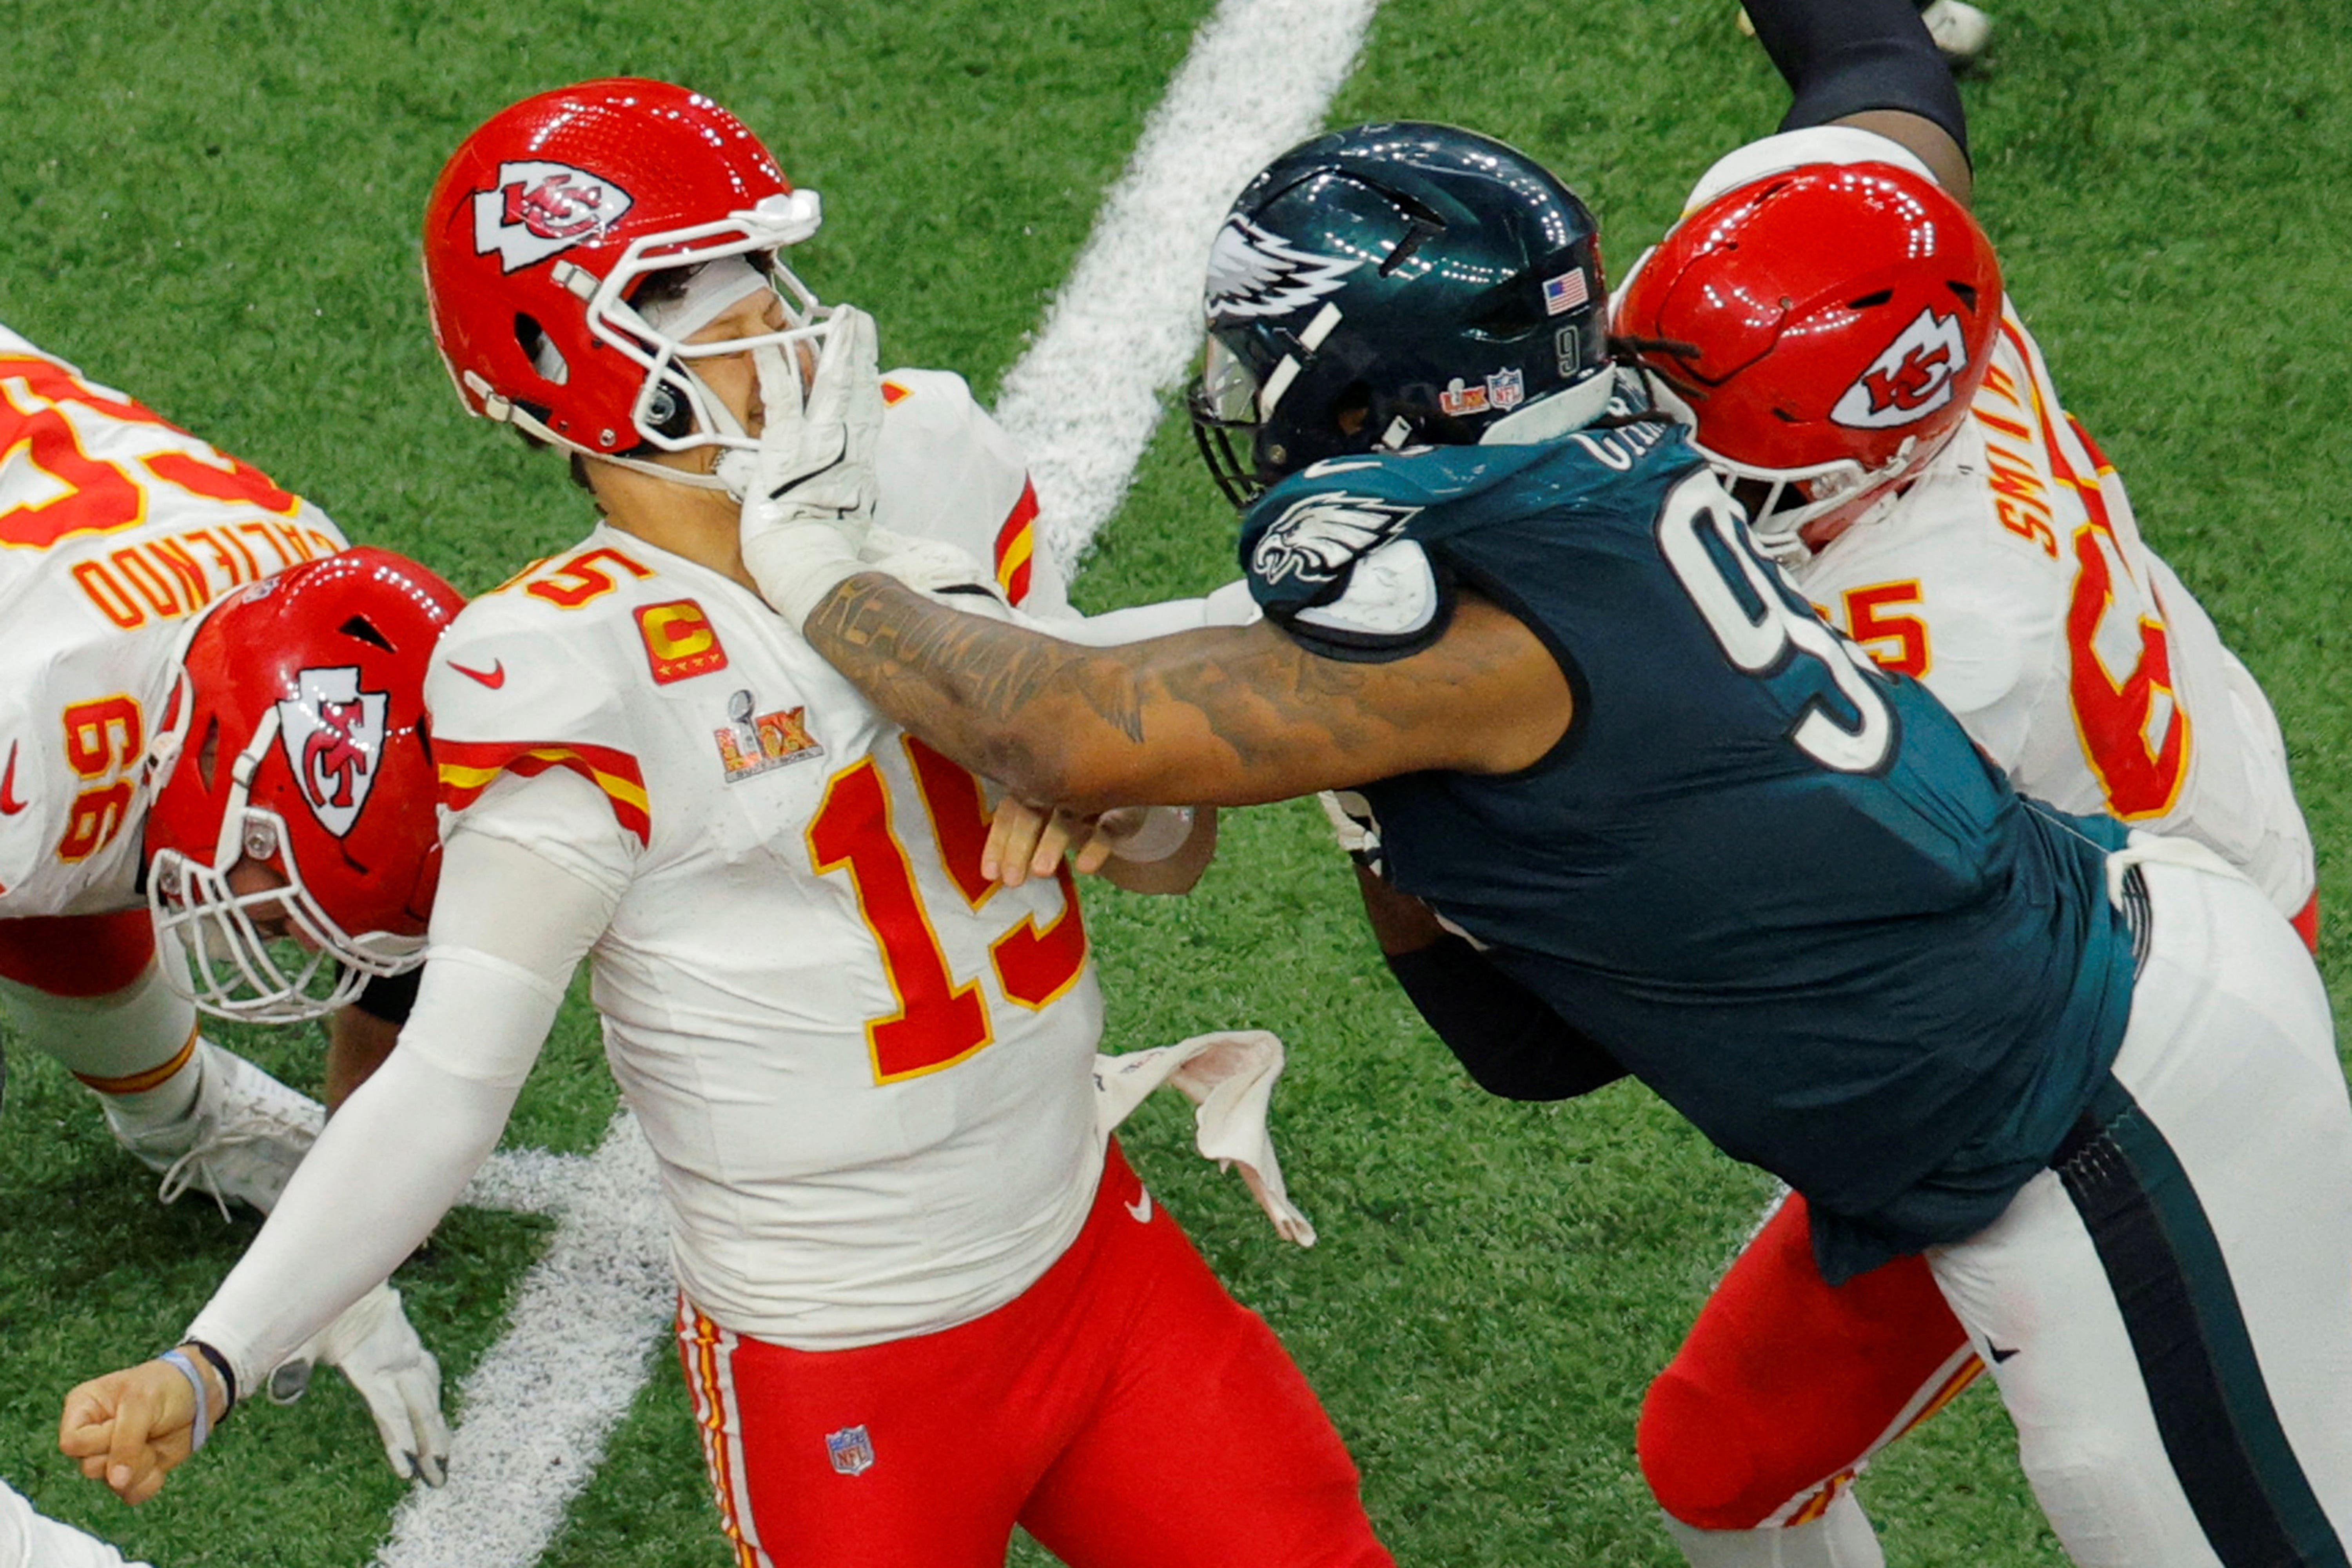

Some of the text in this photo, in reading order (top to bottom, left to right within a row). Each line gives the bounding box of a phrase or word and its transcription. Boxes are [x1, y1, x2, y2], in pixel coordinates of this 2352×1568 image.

[1555, 324, 1581, 378] 9
[642, 603, 713, 661] C
[1809, 577, 1933, 681] 5
[57, 691, 142, 863] 66
[804, 731, 1089, 1086] 15
